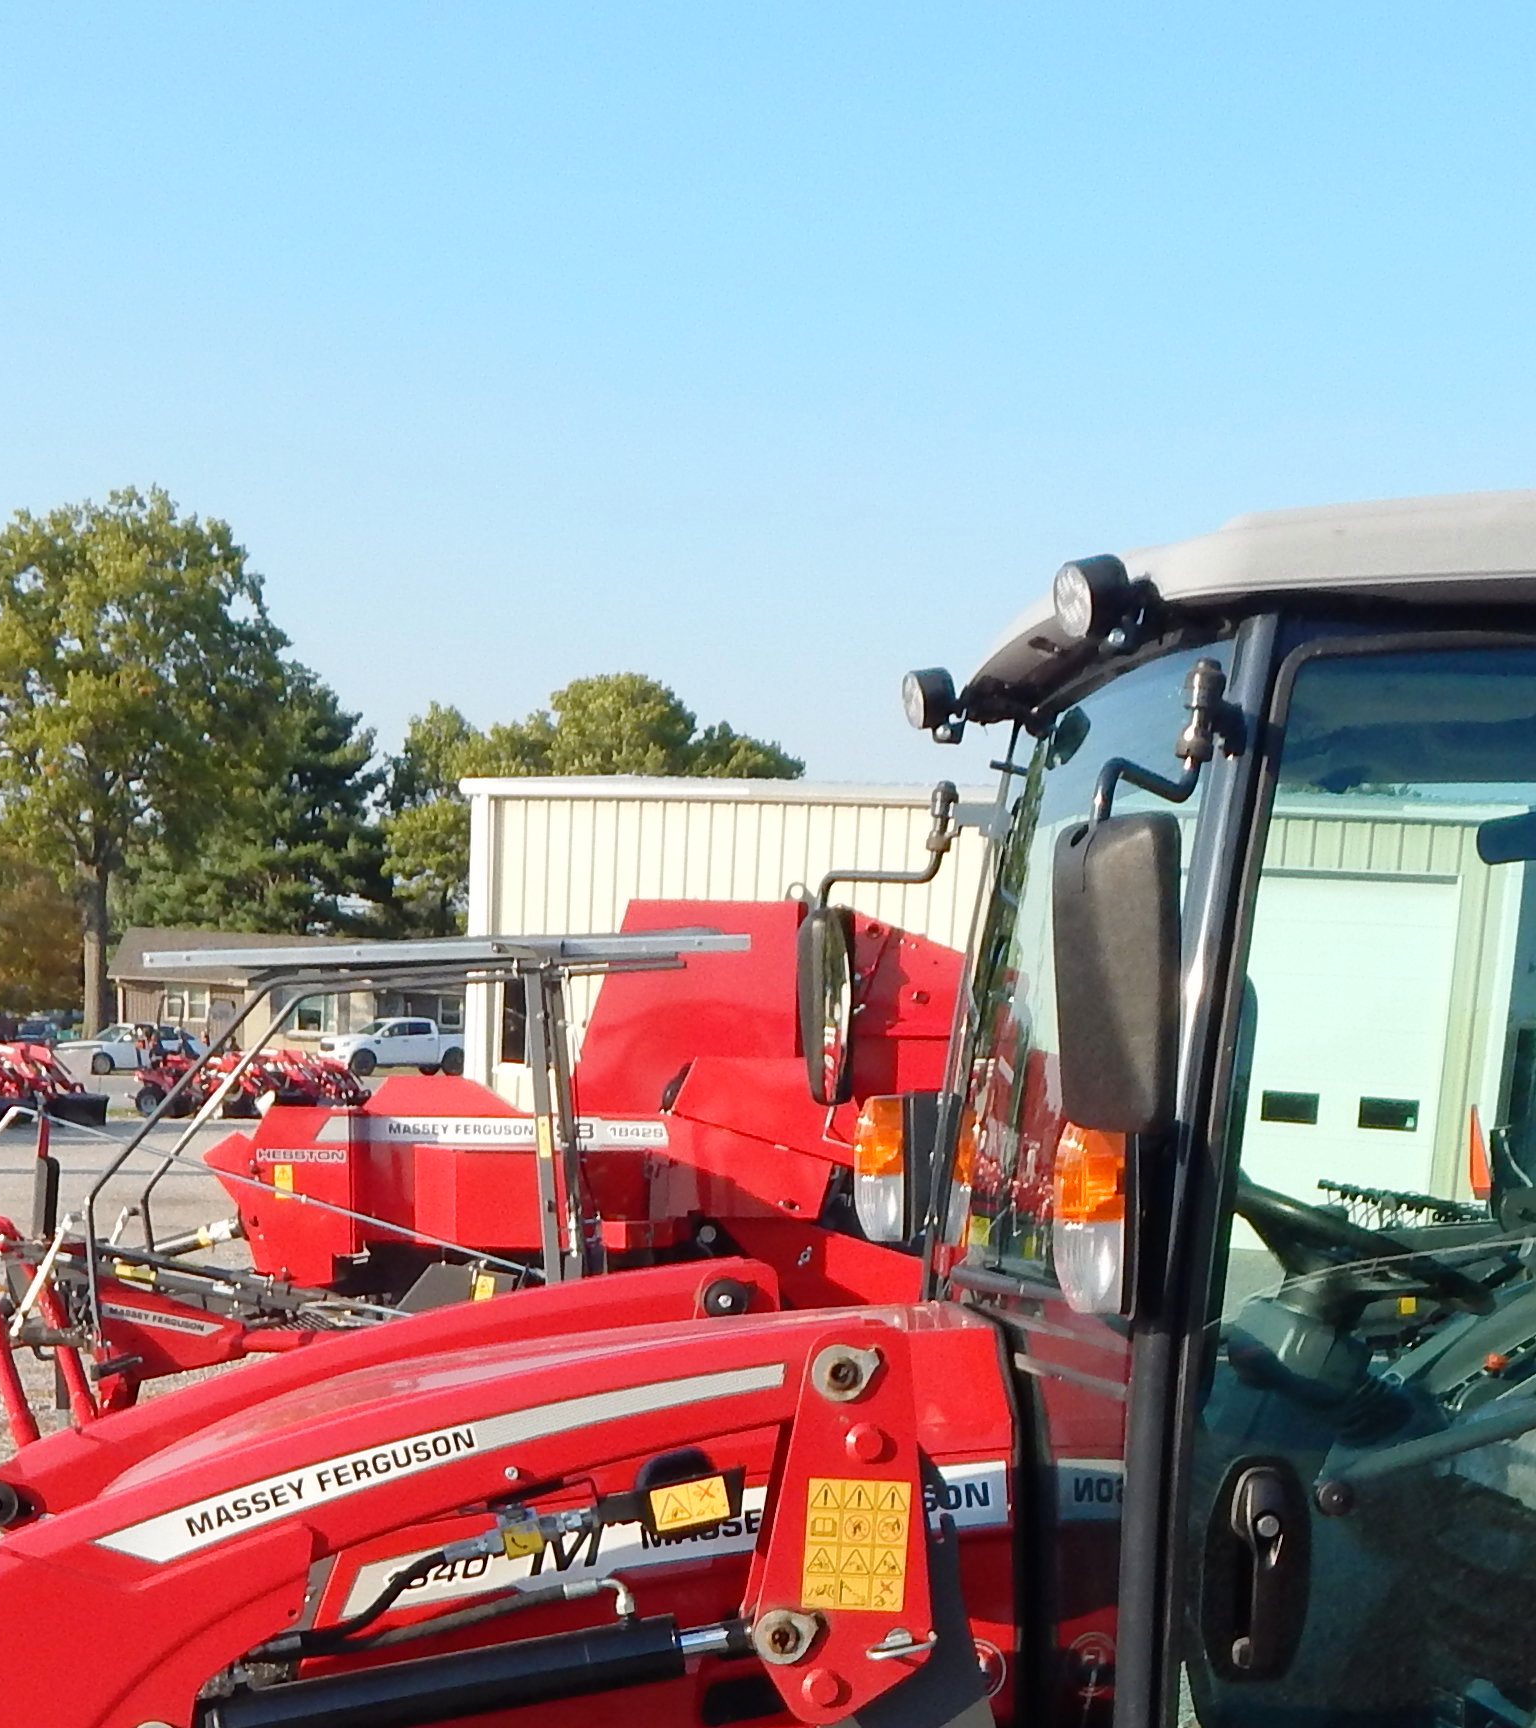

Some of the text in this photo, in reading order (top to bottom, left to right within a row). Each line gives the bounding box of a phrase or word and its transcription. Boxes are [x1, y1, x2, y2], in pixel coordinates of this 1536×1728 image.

[387, 1121, 450, 1136] MASSEY
[454, 1122, 535, 1137] FERGUSON
[256, 1147, 346, 1162] HESSTON
[184, 1427, 476, 1538] MASSEY FERGUSON
